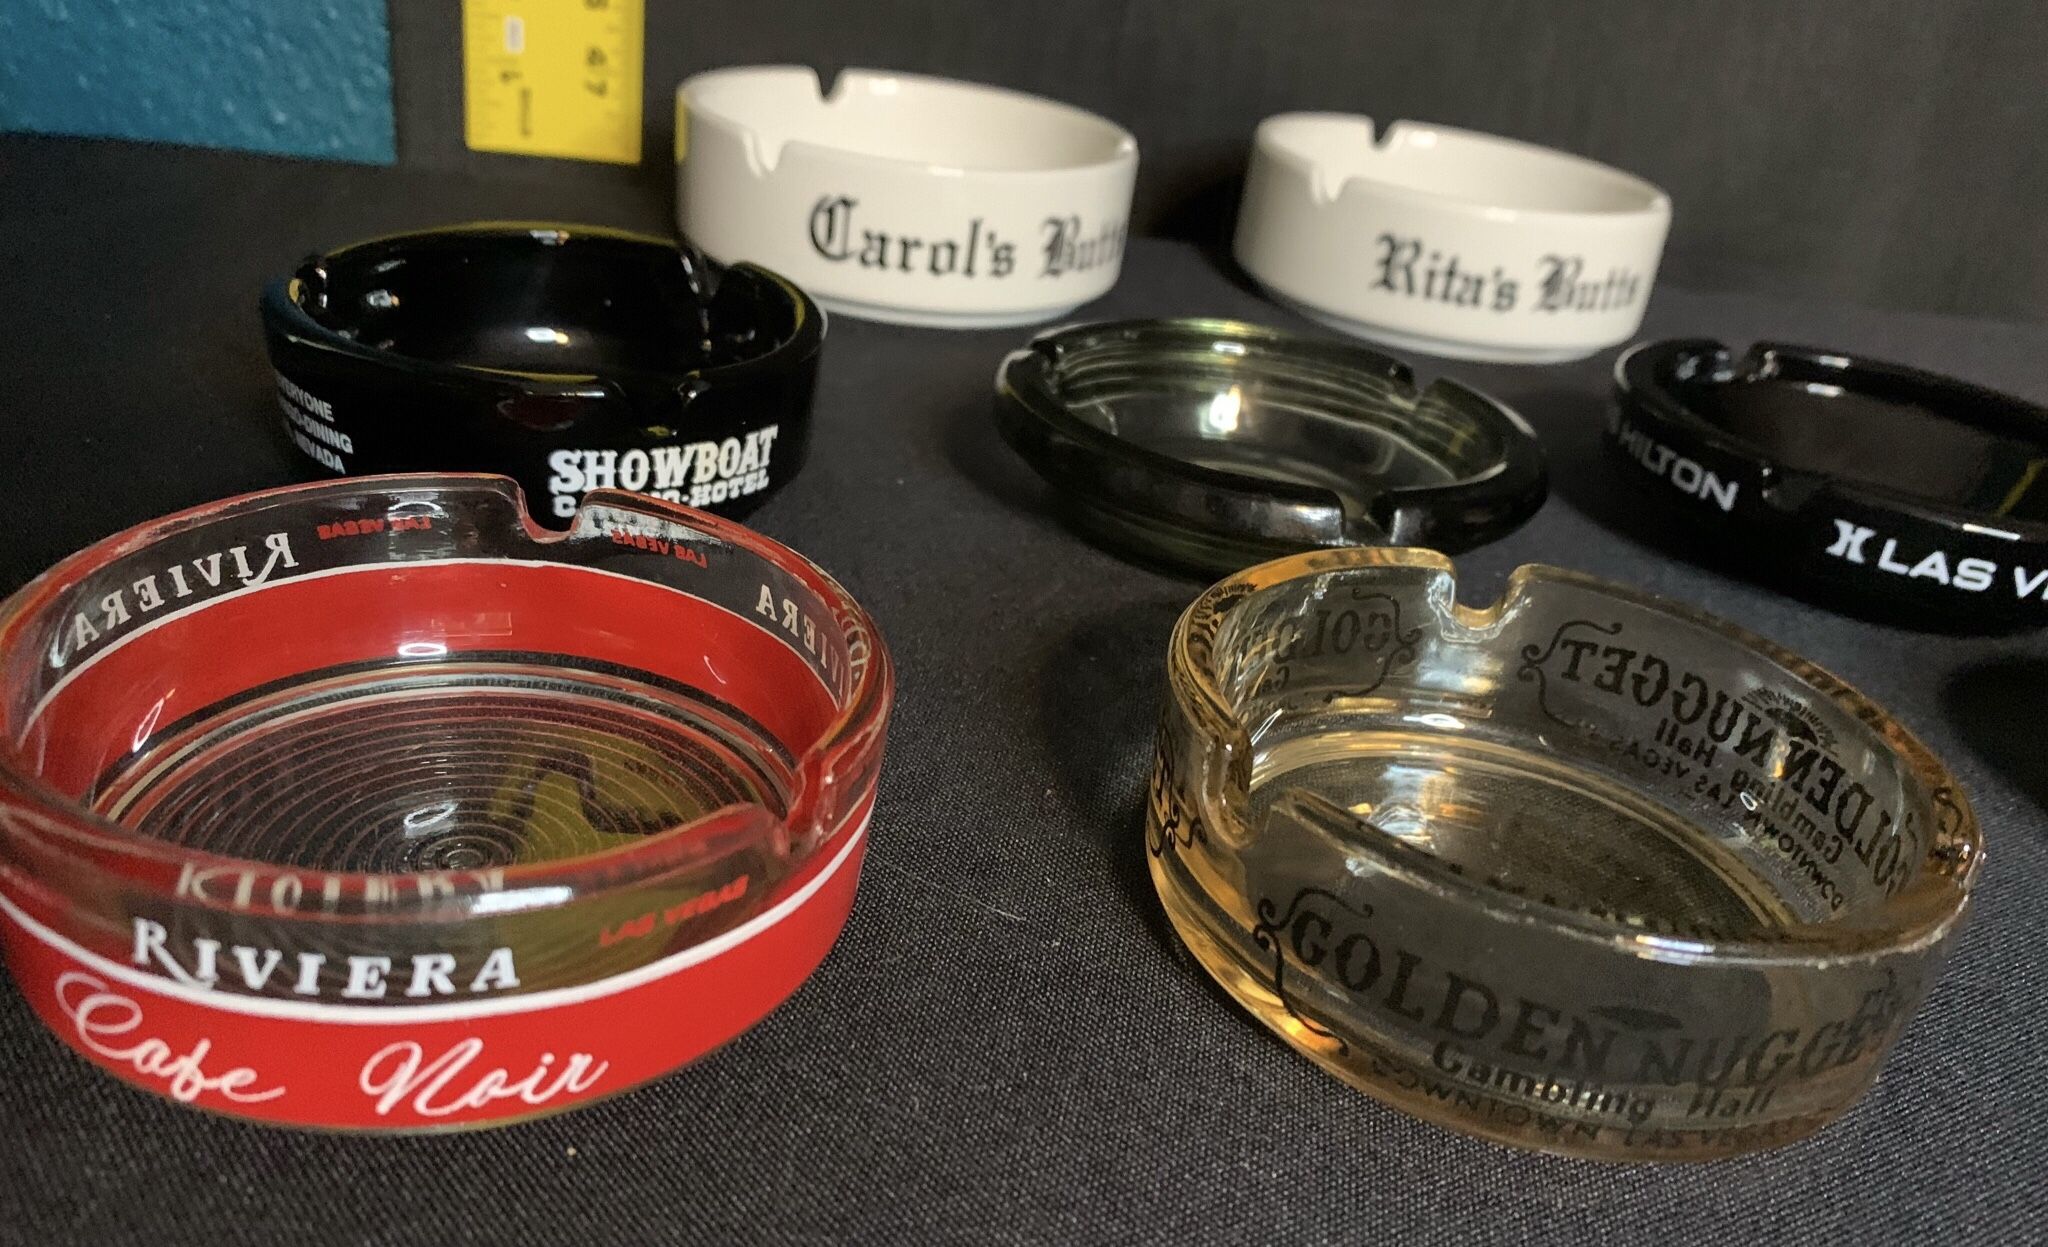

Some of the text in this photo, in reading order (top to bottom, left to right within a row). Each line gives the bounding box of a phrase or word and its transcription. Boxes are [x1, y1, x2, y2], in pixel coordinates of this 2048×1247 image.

[809, 195, 1015, 278] Carol's
[1372, 233, 1520, 312] Rita's
[549, 425, 778, 493] SHOWBOAT
[1878, 538, 1997, 592] LAS
[2014, 566, 2048, 599] V
[132, 917, 520, 1000] RIVIERA
[1291, 910, 1620, 1076] GOLDEN
[359, 1037, 609, 1117] Noir
